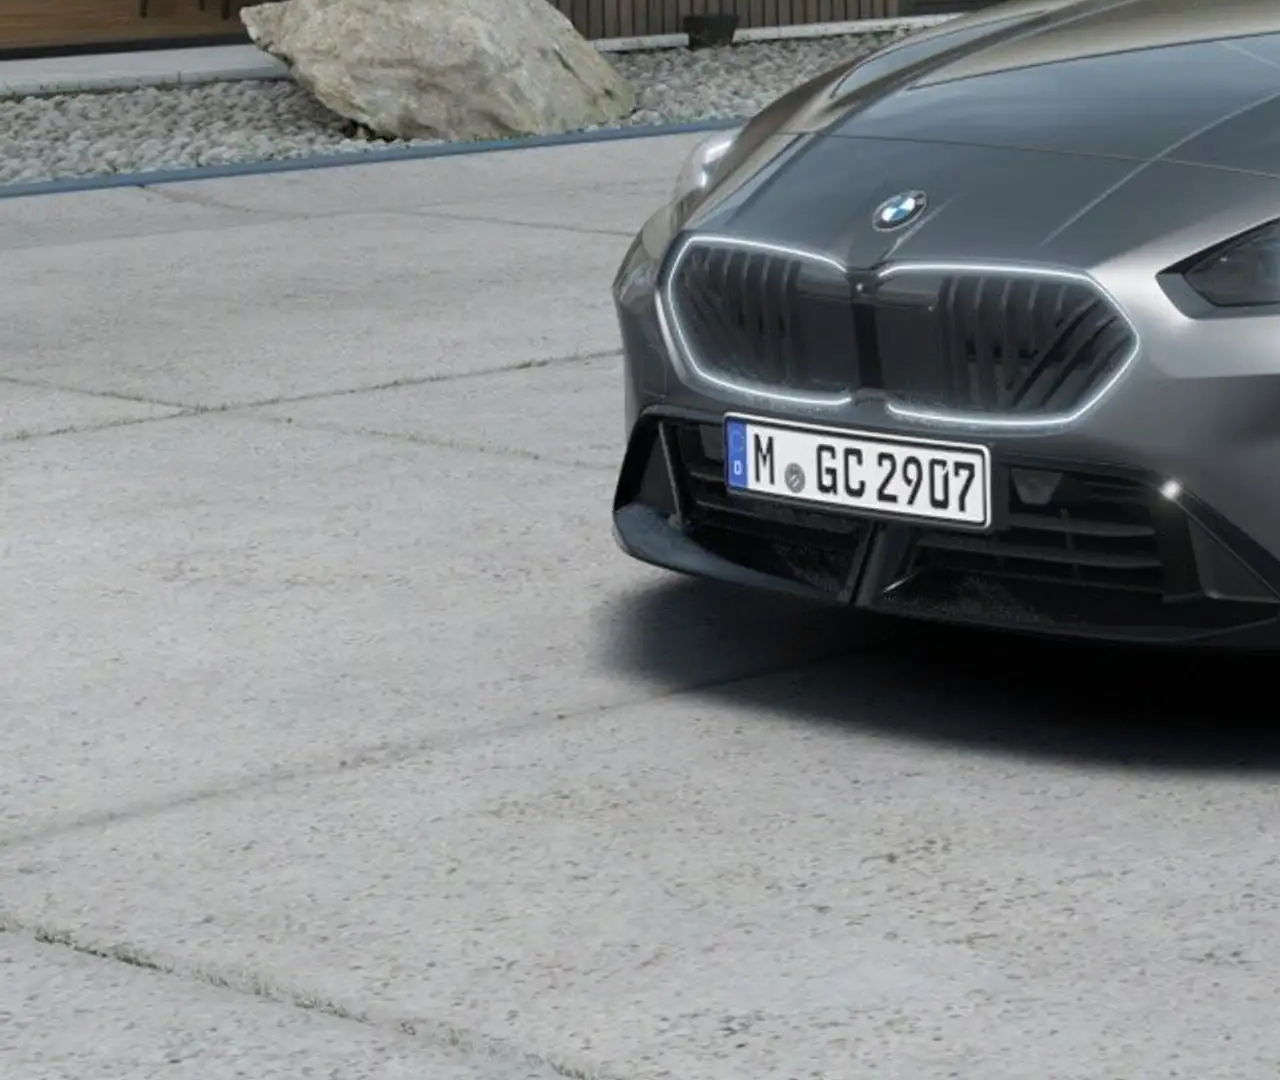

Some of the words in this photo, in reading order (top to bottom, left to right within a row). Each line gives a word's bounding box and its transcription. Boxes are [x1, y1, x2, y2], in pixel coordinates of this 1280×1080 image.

[753, 433, 775, 486] M
[816, 444, 866, 498] GC
[876, 452, 976, 513] 2907
